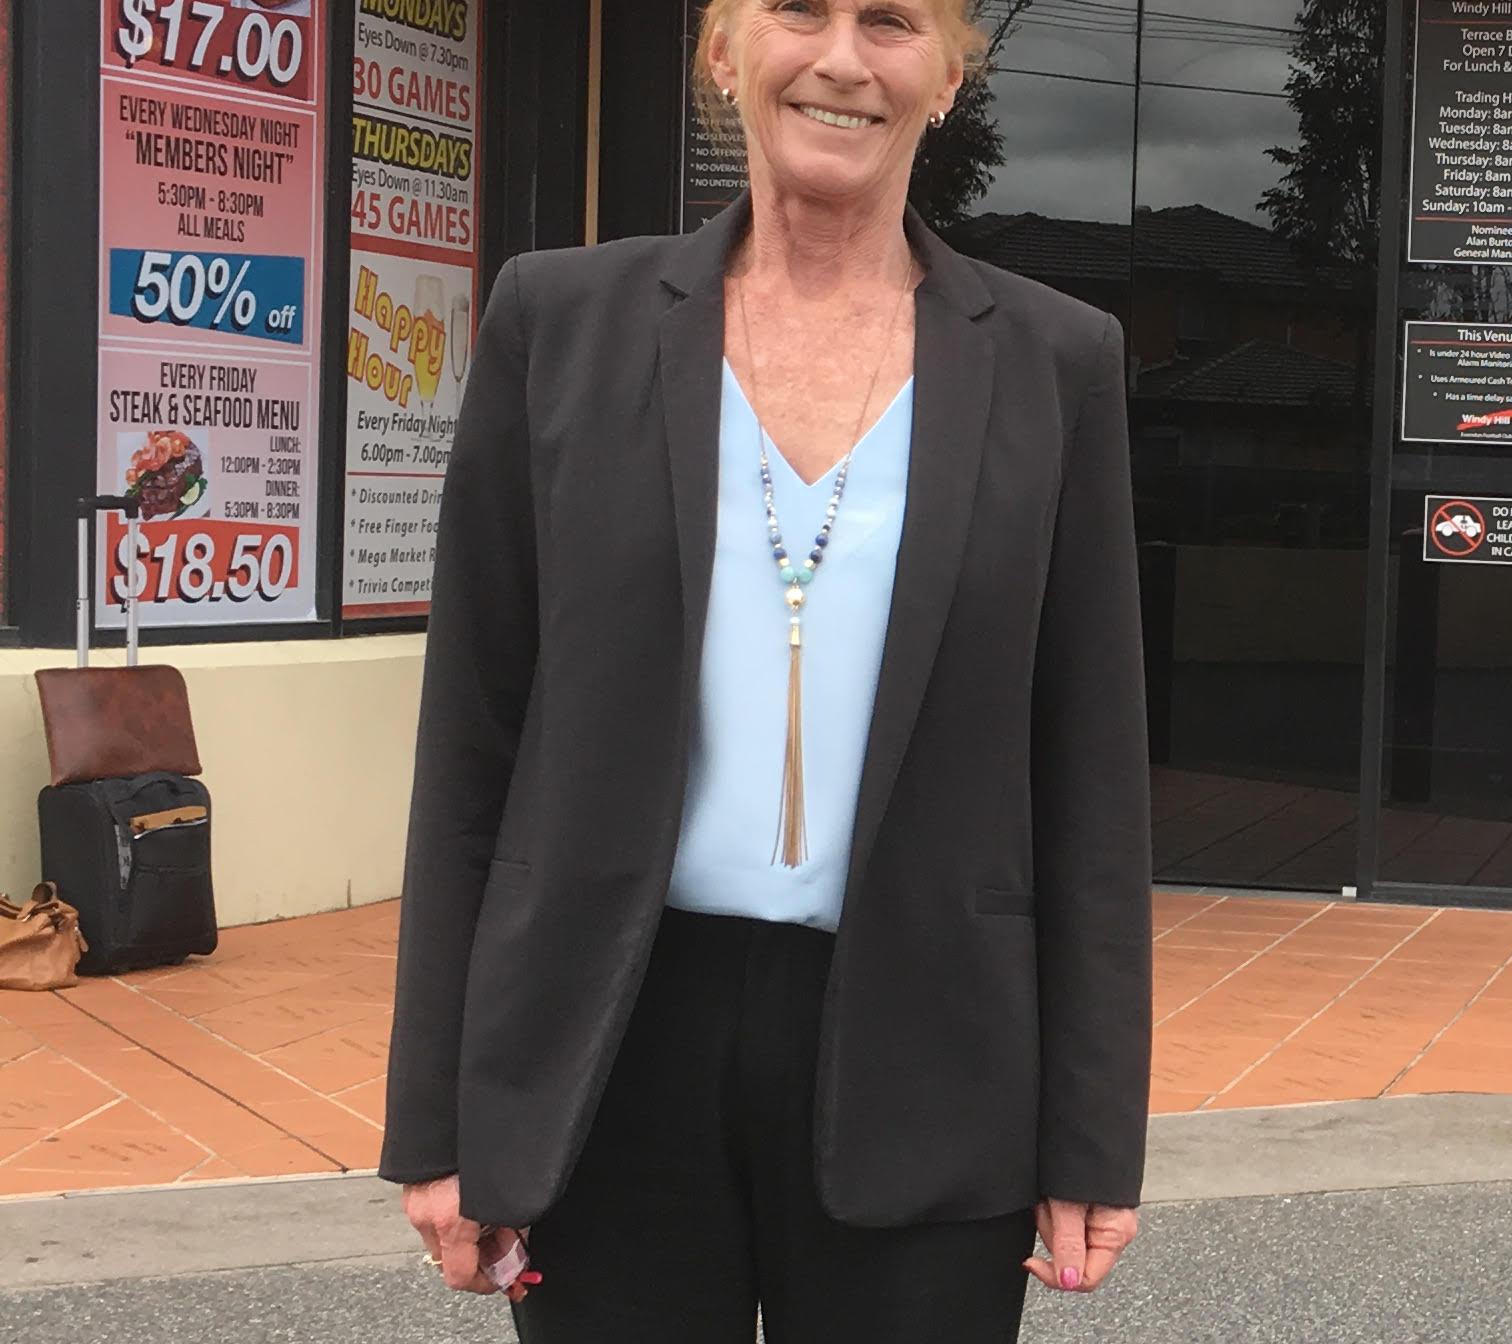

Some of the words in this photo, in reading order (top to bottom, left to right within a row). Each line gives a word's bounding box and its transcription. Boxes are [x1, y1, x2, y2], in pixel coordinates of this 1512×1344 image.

[1452, 2, 1489, 16] Windy
[1492, 2, 1512, 14] Hill
[1461, 28, 1504, 41] Terrace
[358, 22, 383, 48] Eyes
[385, 30, 417, 56] Down
[418, 43, 430, 62] @
[430, 44, 469, 72] 7.30pm
[1462, 44, 1496, 58] Open
[1498, 45, 1506, 57] 7
[1443, 59, 1462, 72] For
[1464, 60, 1501, 73] Lunch
[1503, 61, 1512, 73] &
[353, 57, 382, 100] 30
[388, 66, 471, 122] GAMES
[1455, 90, 1500, 106] Trading
[120, 95, 167, 127] EVERY
[170, 102, 257, 141] WEDNESDAY
[260, 118, 300, 148] NIGHT
[1439, 106, 1491, 121] Monday:
[1439, 122, 1491, 137] Tuesday:
[352, 115, 472, 180] THURSDAYS
[1429, 137, 1500, 153] Wednesday:
[694, 162, 709, 172] NO
[1435, 153, 1493, 169] Thursday:
[694, 177, 709, 188] NO
[709, 178, 740, 189] UNTIDY
[1443, 169, 1483, 184] Friday:
[1484, 170, 1511, 182] 8am
[158, 182, 206, 210] 5:30PM
[218, 190, 264, 217] 8:30PM
[1435, 184, 1491, 200] Saturday:
[1422, 199, 1470, 214] Sunday:
[1472, 201, 1505, 213] 10am
[351, 190, 382, 230] 45
[388, 195, 471, 246] GAMES
[178, 213, 201, 237] ALL
[203, 216, 245, 242] MEALS
[134, 251, 257, 326] 50%
[267, 305, 297, 330] off
[354, 265, 446, 377] Happy
[1457, 329, 1482, 342] This
[1437, 349, 1459, 358] under
[1460, 350, 1470, 359] 24
[1471, 351, 1488, 359] hour
[1489, 351, 1511, 360] Video
[347, 327, 413, 408] Hour
[1457, 359, 1480, 367] Alarm
[160, 362, 206, 390] EVERY
[208, 365, 257, 393] FRIDAY
[1430, 375, 1448, 384] Uses
[1449, 375, 1487, 385] Armoured
[1487, 376, 1506, 385] Cash
[109, 390, 163, 425] STEAK
[168, 393, 178, 425] &
[182, 394, 252, 428] SEAFOOD
[257, 398, 300, 431] MENU
[1462, 414, 1493, 426] Windy
[1493, 415, 1511, 425] Hill
[113, 526, 293, 600] $18.50
[357, 548, 387, 568] Mega
[390, 547, 427, 564] Market
